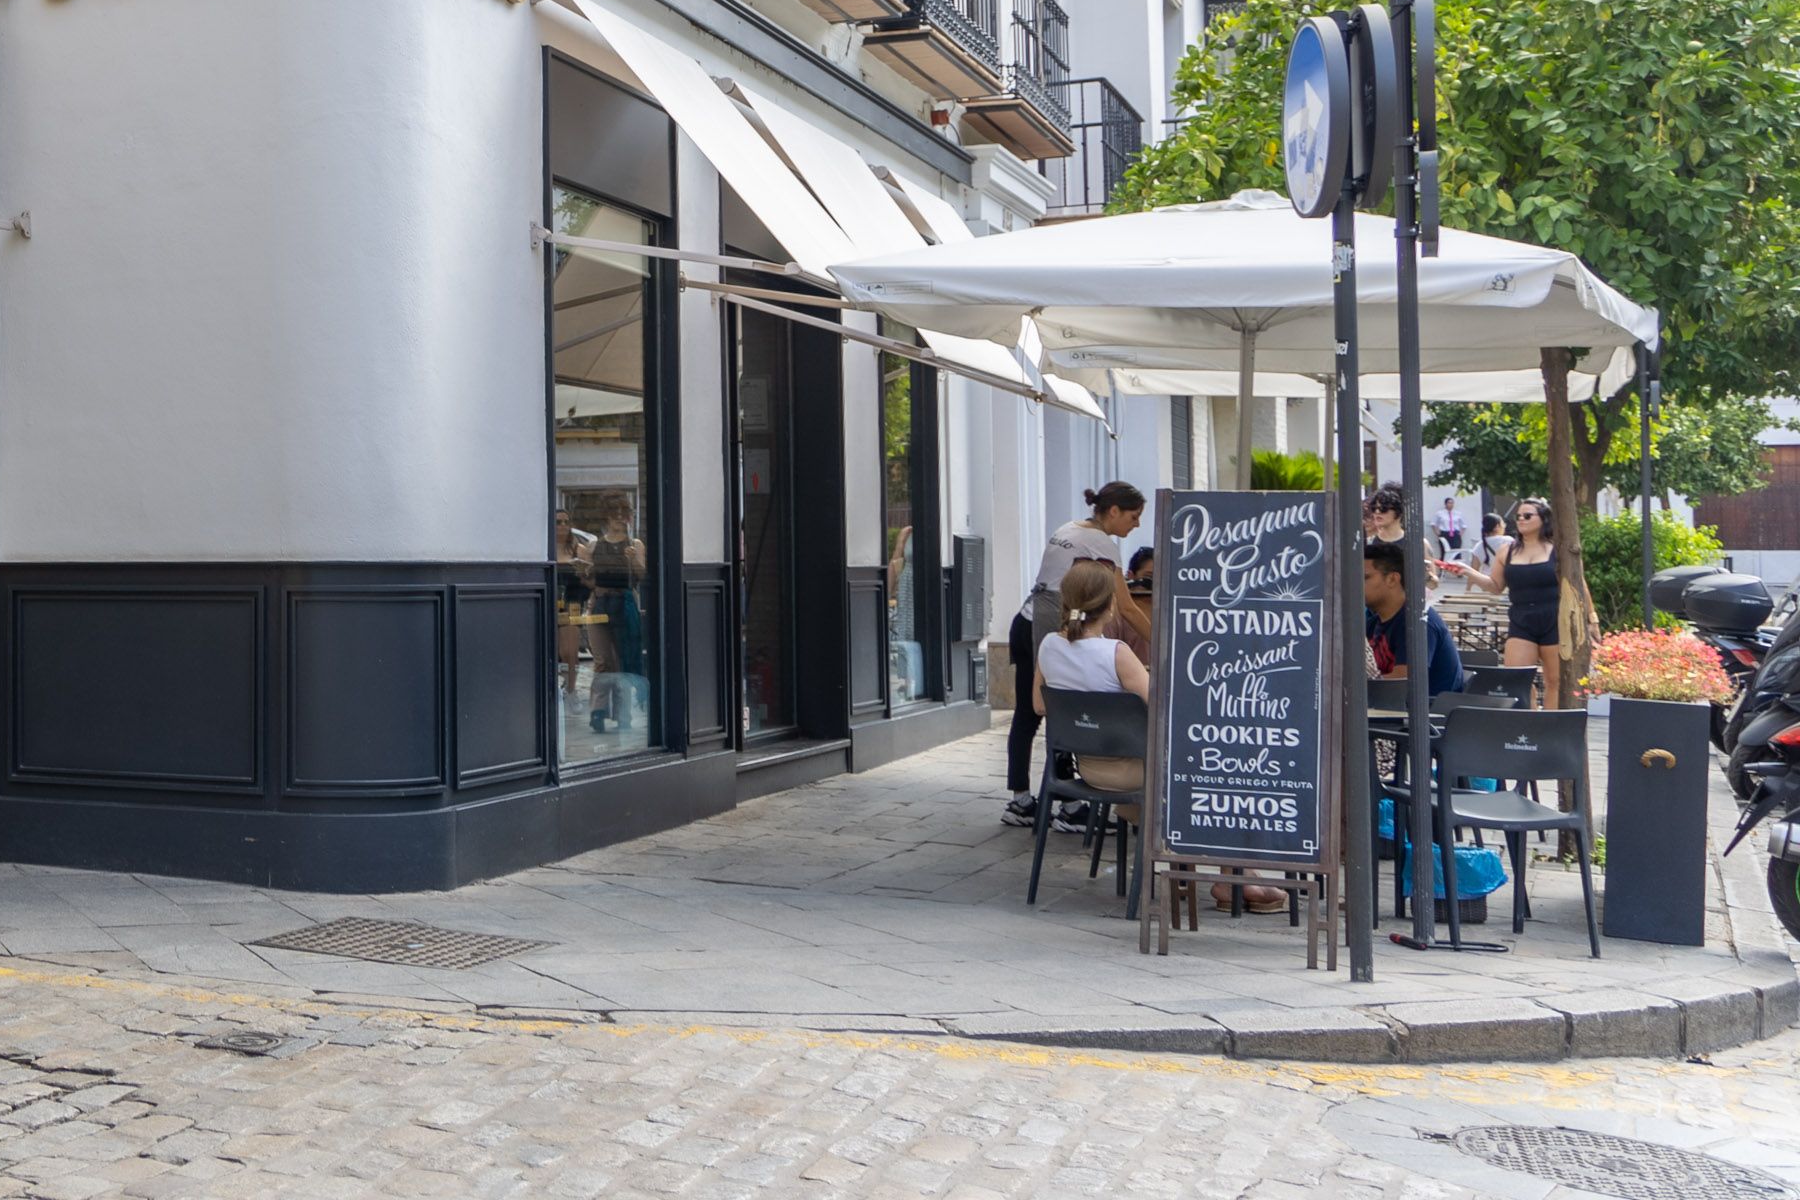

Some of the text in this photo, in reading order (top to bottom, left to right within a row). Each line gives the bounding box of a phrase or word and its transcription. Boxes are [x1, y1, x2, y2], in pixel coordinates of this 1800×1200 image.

[1171, 501, 1317, 560] Desayuna
[1177, 530, 1323, 608] CON Gusto
[1179, 608, 1313, 637] TOSTADAS
[1186, 639, 1300, 687] Croissant
[1206, 672, 1291, 720] Muffins
[1187, 723, 1301, 747] COOKIES
[1504, 742, 1538, 752] Heineken
[1200, 747, 1282, 776] Bowls
[1173, 773, 1314, 790] DE YOGUR GRIEGO Y FRUTA
[1190, 792, 1299, 819] ZUMOS
[1190, 813, 1298, 833] NATURALES
